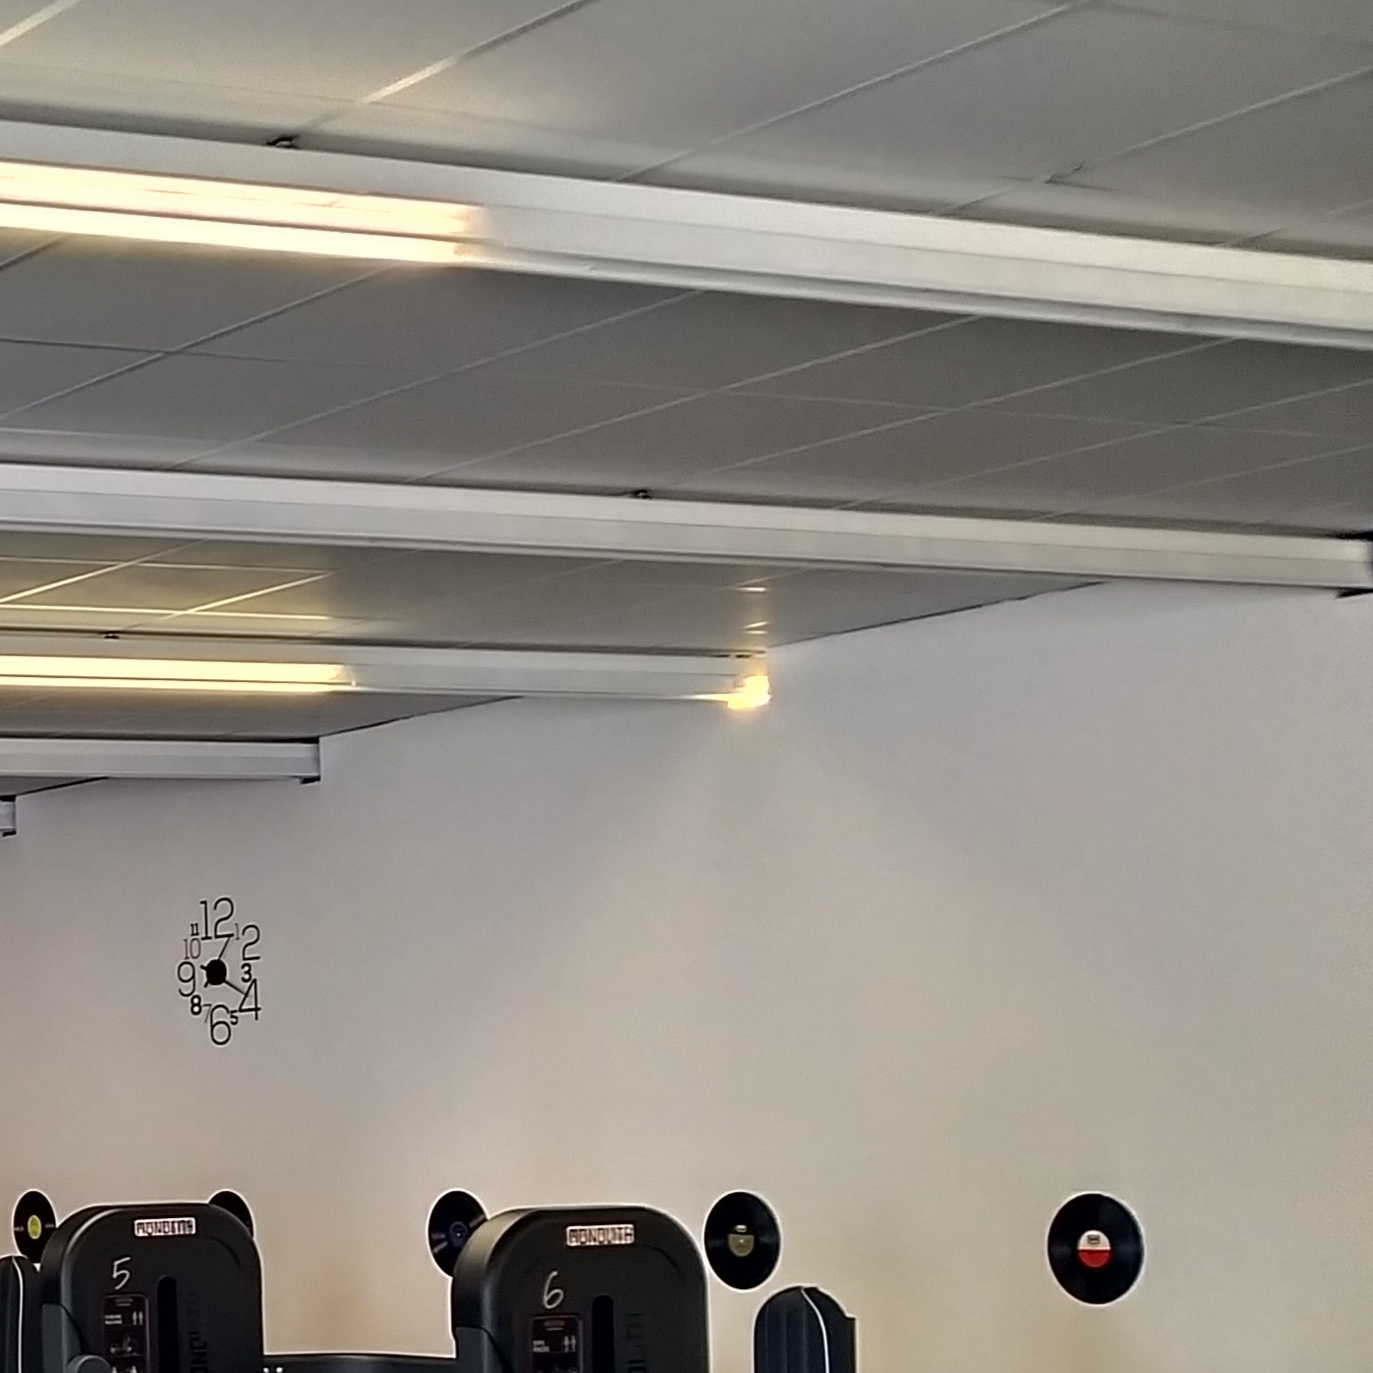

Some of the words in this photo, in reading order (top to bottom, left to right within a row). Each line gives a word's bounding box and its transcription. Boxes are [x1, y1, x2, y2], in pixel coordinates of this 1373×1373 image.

[199, 897, 234, 940] 12
[183, 938, 202, 960] 10
[242, 924, 261, 961] 2
[177, 961, 196, 997] 9
[241, 963, 252, 983] 3
[190, 995, 202, 1016] 8
[230, 1010, 239, 1025] 5
[238, 978, 262, 1021] 4
[210, 1004, 231, 1045] 6
[112, 1256, 131, 1290] 5
[543, 1270, 564, 1309] 6
